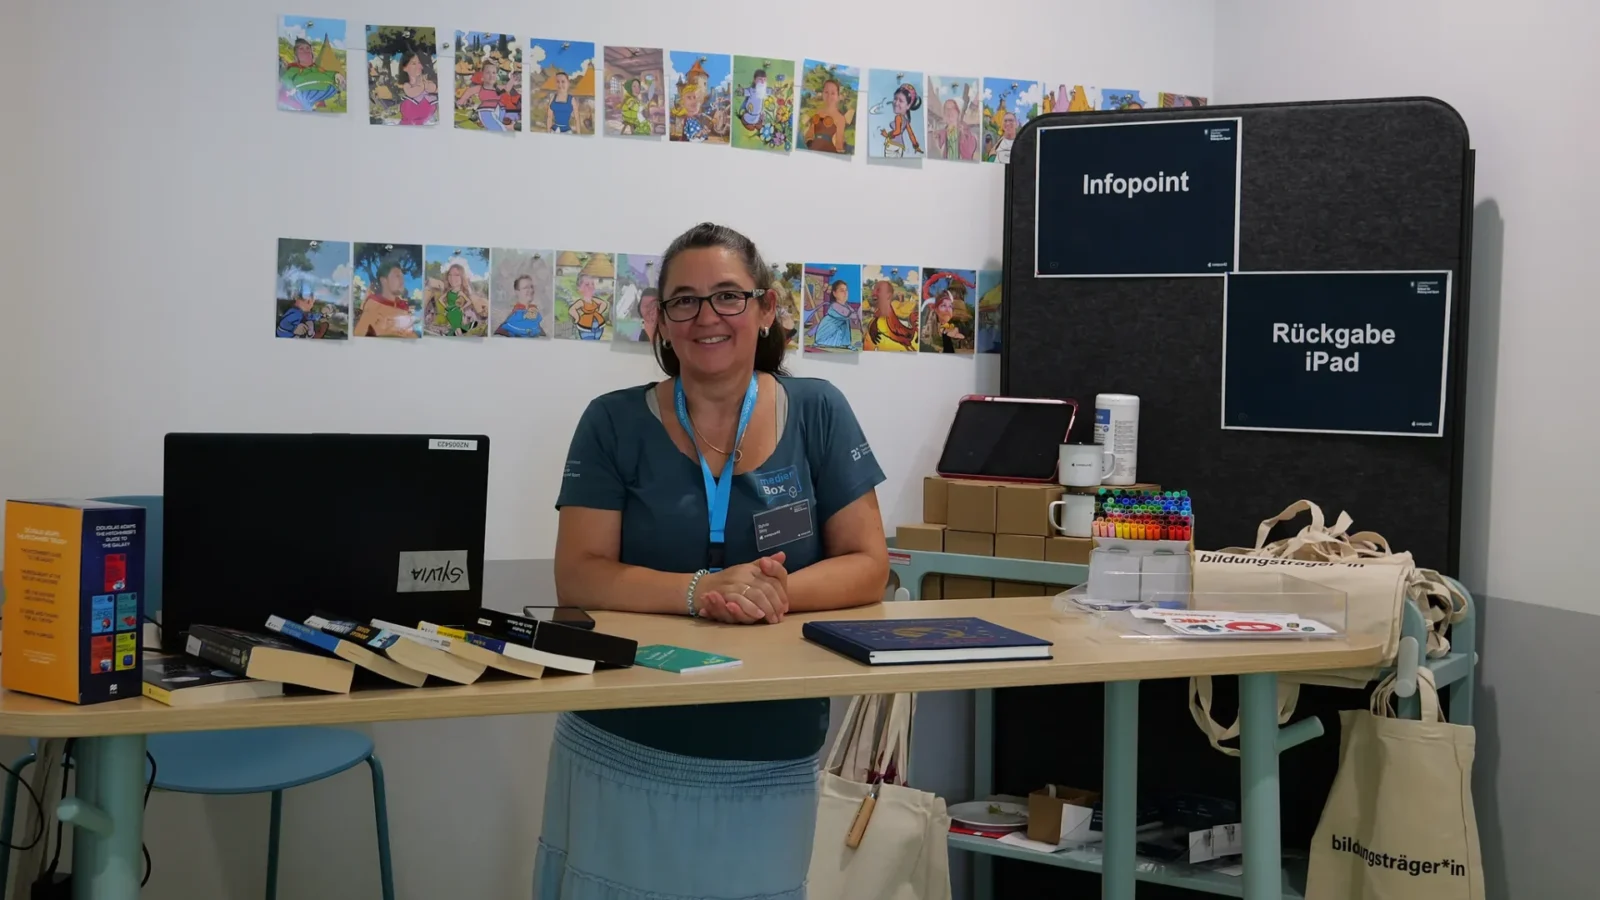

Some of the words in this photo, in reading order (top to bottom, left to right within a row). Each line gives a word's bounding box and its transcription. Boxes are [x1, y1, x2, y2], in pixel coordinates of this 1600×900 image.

[1083, 171, 1189, 198] Infopoint
[1273, 323, 1396, 349] Rückgabe
[1305, 351, 1360, 372] iPad
[763, 485, 786, 495] Box
[411, 560, 464, 584] SYLVIA
